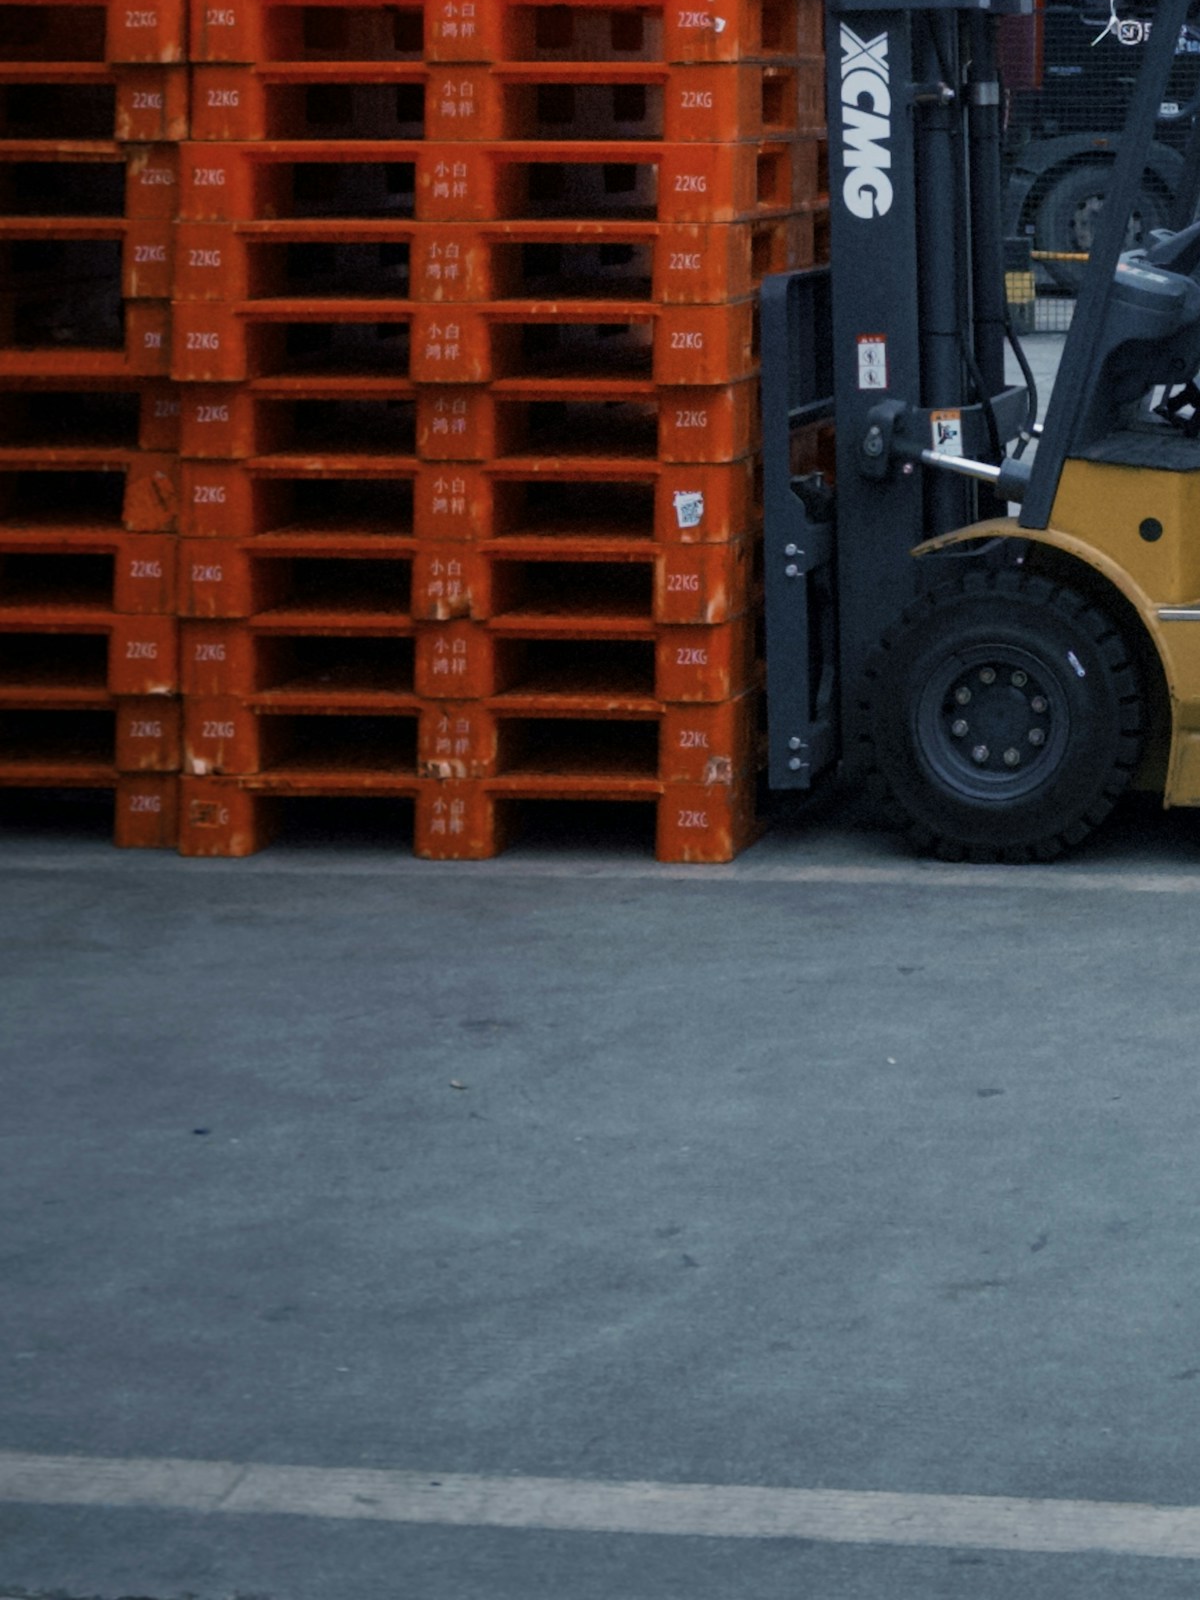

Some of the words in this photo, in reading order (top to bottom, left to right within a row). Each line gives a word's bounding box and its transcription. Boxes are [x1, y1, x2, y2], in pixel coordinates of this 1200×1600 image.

[443, 2, 475, 18] 小白
[678, 10, 709, 27] 22KG
[125, 11, 157, 28] 22KG
[442, 80, 474, 97] 小白
[132, 92, 161, 109] 22KG
[207, 90, 239, 107] 22KG
[681, 91, 713, 108] 22KG
[840, 21, 894, 220] XCMG
[194, 169, 225, 185] 22KG
[434, 161, 467, 178] 小白
[675, 175, 707, 193] 22KG
[134, 245, 165, 262] 22KG
[189, 250, 221, 267] 22KG
[429, 242, 460, 259] 小白
[428, 323, 460, 340] 小白
[187, 332, 219, 350] 22KG
[671, 332, 703, 349] 22KG
[197, 405, 229, 423] 22KG
[675, 410, 707, 428] 22KG
[433, 477, 465, 494] 小白
[194, 486, 225, 503] 22KG
[130, 561, 161, 578] 22KG
[192, 565, 222, 582] 22KG
[431, 559, 461, 577] 小白
[667, 574, 699, 591] 22KG
[126, 641, 157, 659] 22KG
[195, 644, 225, 661] 22KG
[434, 637, 467, 654] 小白
[676, 648, 707, 665] 22KG
[131, 721, 161, 738] 22KG
[203, 721, 234, 738] 22KG
[438, 716, 470, 734] 小白
[131, 795, 161, 812] 22KG
